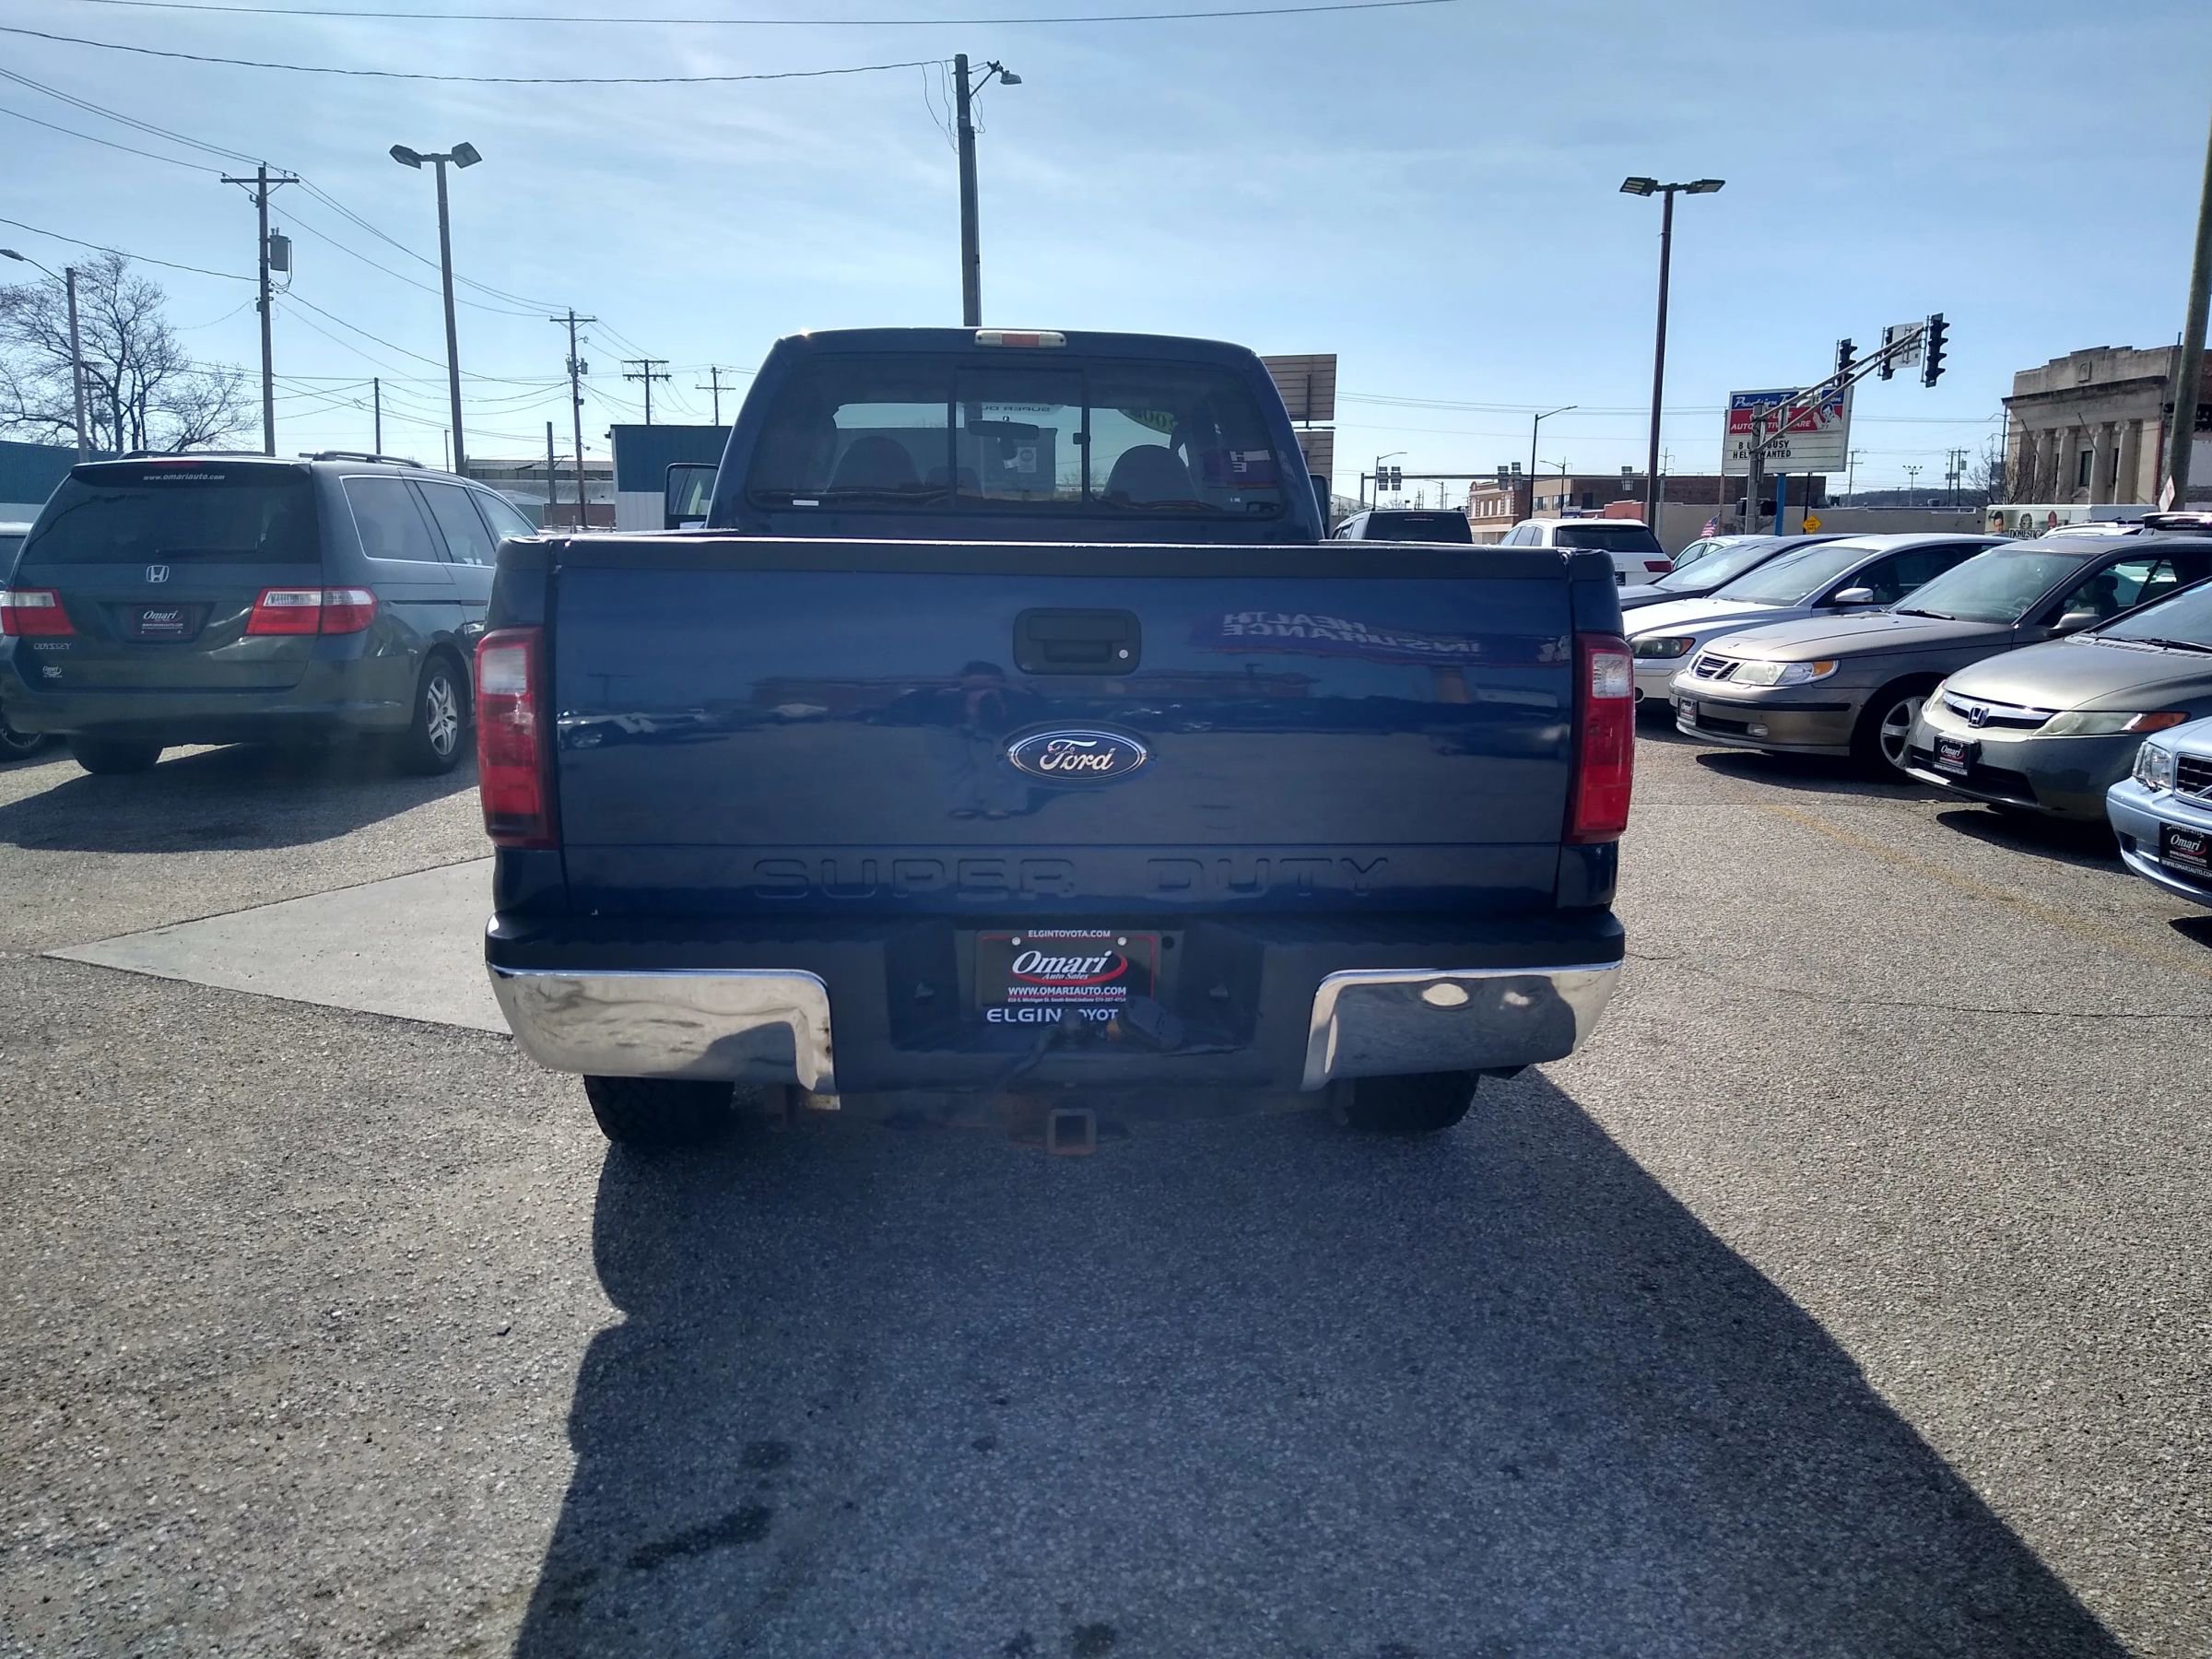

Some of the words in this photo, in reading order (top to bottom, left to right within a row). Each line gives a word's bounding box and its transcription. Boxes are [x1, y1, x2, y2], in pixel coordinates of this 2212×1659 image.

[143, 610, 178, 620] Omari
[1040, 739, 1116, 771] Ford
[1940, 745, 1962, 757] Omari
[2171, 833, 2202, 851] Omari
[753, 858, 1076, 901] SUPER
[1147, 858, 1389, 901] DUTY
[1028, 930, 1111, 938] ELGINTOYOTA.COM
[1012, 950, 1113, 974] Omari
[1007, 986, 1126, 995] WWW.OMARIAUTO.COM
[986, 1008, 1062, 1022] ELGIN
